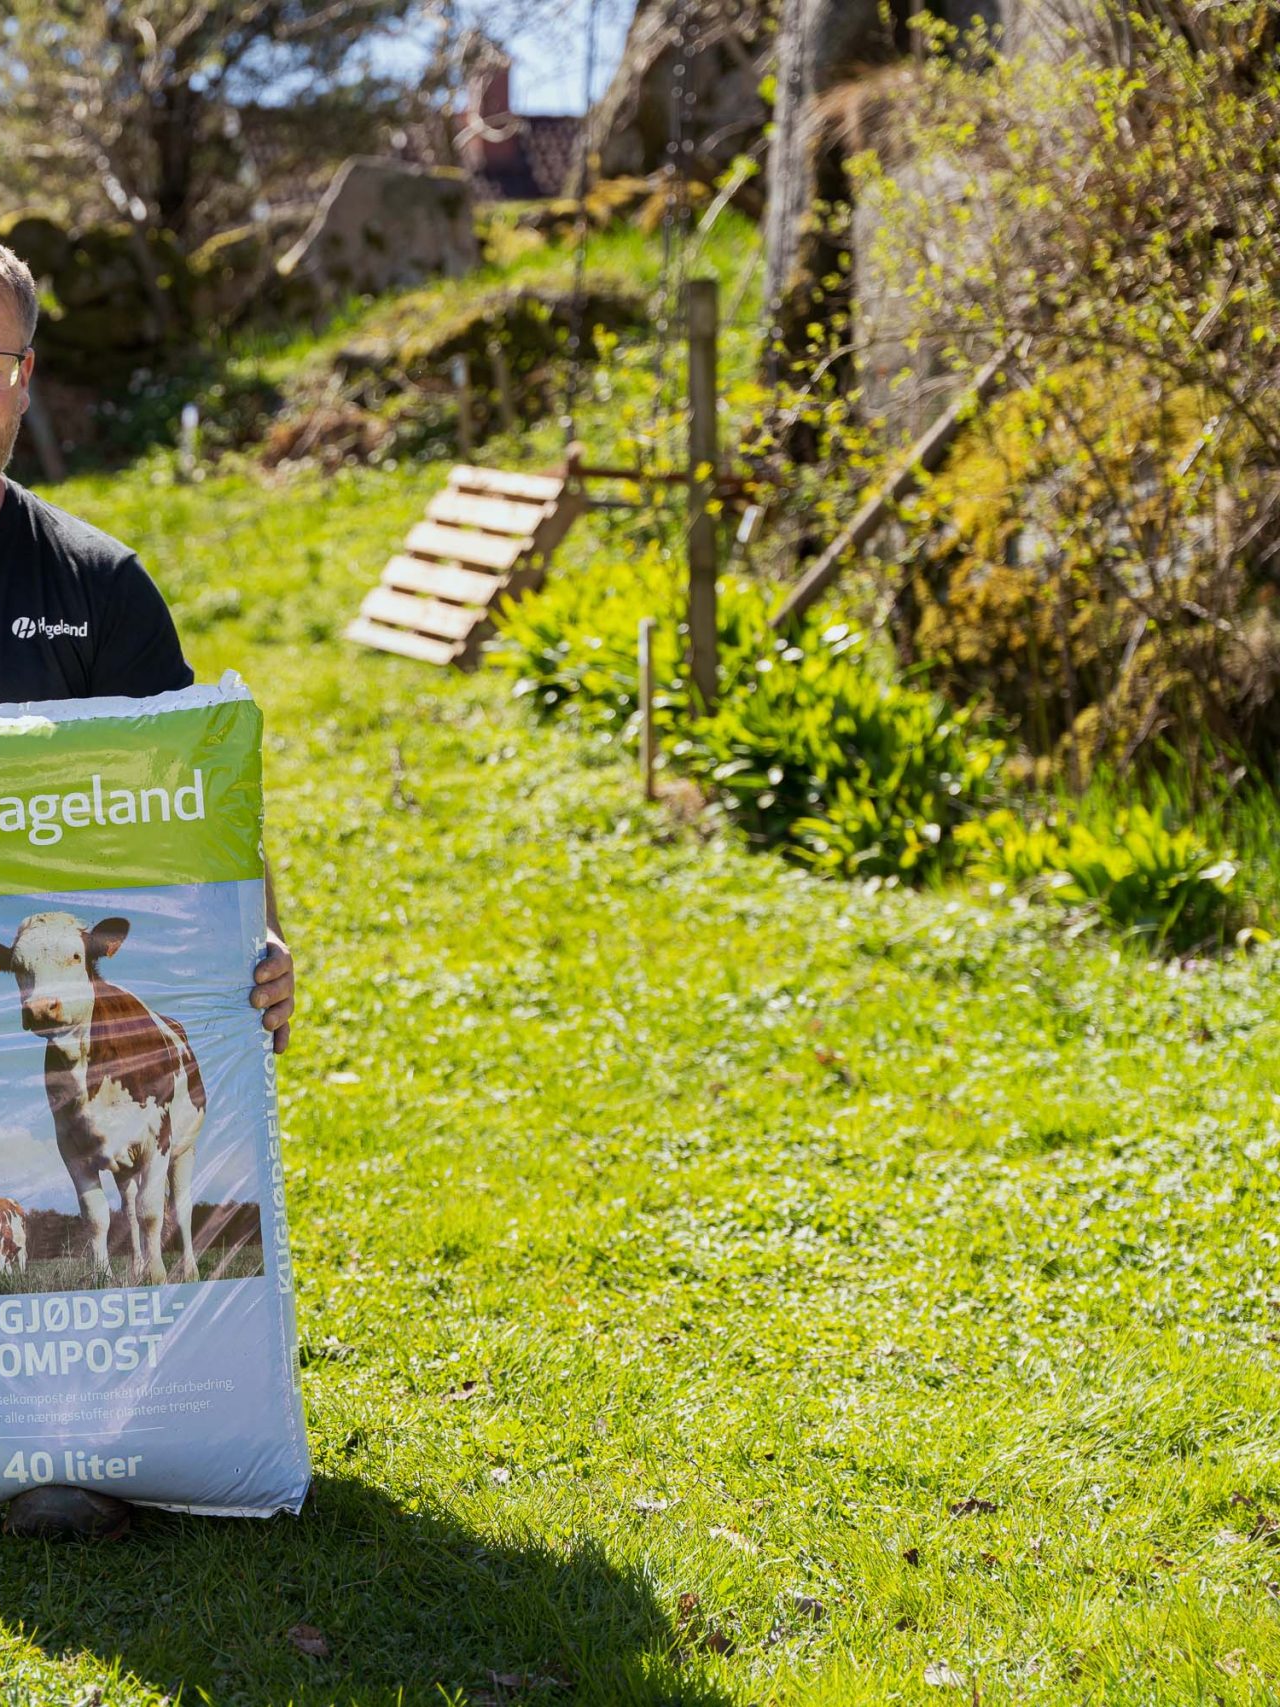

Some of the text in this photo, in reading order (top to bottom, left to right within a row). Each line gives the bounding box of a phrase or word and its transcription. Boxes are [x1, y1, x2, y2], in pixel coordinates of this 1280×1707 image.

[65, 1393, 77, 1403] er
[80, 1387, 133, 1402] utmerket
[4, 1410, 25, 1424] alle
[27, 1406, 114, 1425] næringsstoffer
[116, 1403, 167, 1420] plantene
[3, 1449, 143, 1484] 40 liter
